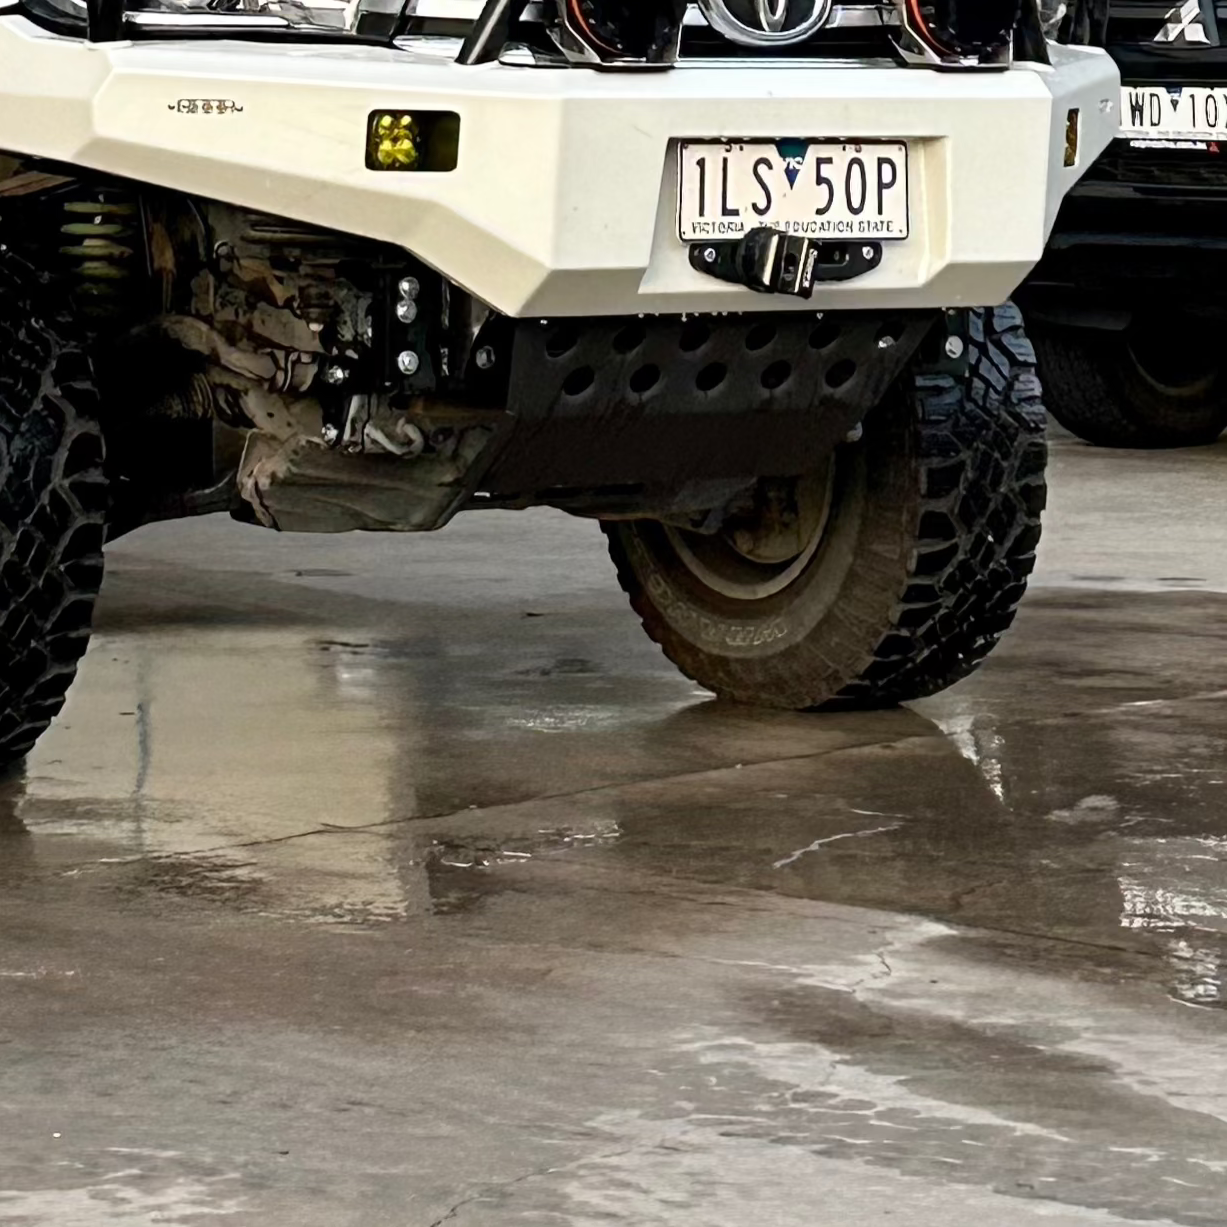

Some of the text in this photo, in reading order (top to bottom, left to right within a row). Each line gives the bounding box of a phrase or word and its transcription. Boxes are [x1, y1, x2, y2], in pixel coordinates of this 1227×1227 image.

[695, 156, 774, 217] 1LS
[691, 221, 745, 235] VICTORIA
[858, 220, 894, 233] STATE
